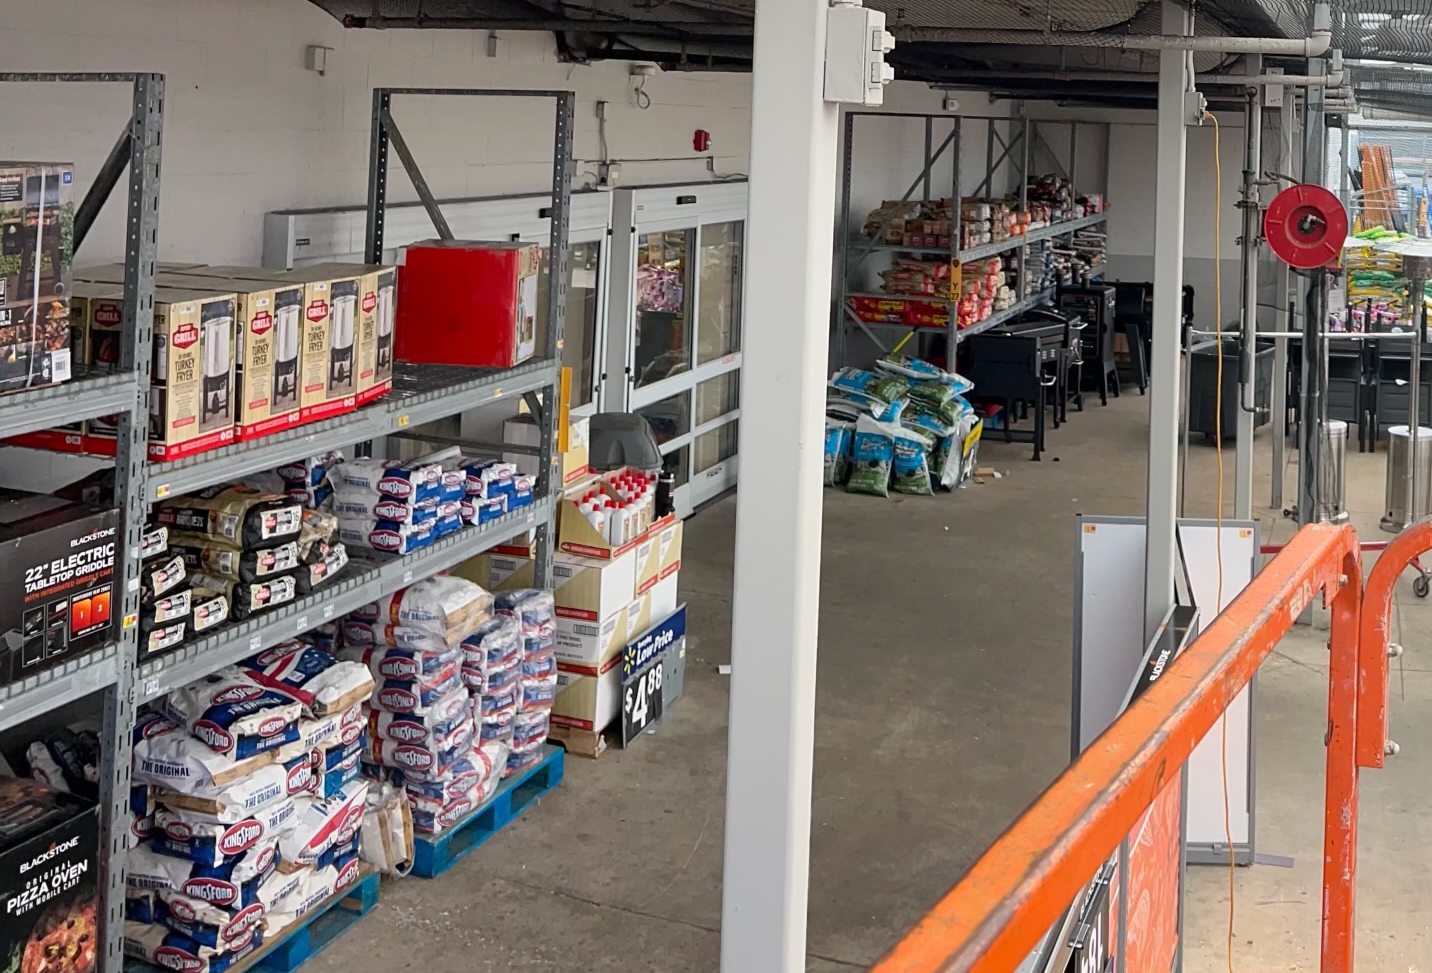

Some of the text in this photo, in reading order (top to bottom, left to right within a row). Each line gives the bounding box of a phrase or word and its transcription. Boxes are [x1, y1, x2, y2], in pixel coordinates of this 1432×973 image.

[952, 282, 959, 291] Y
[173, 331, 197, 345] GRILL
[174, 357, 196, 372] TURKEY
[176, 369, 194, 383] FRYER
[378, 482, 411, 495] KINGSFORD
[374, 505, 407, 517] KINGSFORD
[70, 526, 116, 548] BLACKSTONE
[370, 534, 402, 546] KINGSFORD
[24, 542, 115, 584] 22" ELECTRIC
[24, 556, 115, 594] TABLETOP GRIDDLE
[24, 567, 115, 603] WITH INTEGRATED GRIDDLE CART
[636, 629, 674, 666] Low Price
[214, 687, 264, 704] KINGSFORD
[194, 725, 229, 747] KINGSFORD
[259, 719, 286, 735] KINGSFORD
[389, 723, 427, 741] KINGSFORD
[393, 747, 431, 766] KINGSFORD
[141, 760, 191, 778] THE ORIGINAL
[244, 787, 282, 809] THE ORIGINAL
[222, 823, 261, 850] KINGSFORD
[20, 835, 81, 875] BLACKSTONE
[25, 859, 72, 890] ORIGINAL
[6, 858, 89, 914] PIZZA OVEN
[15, 875, 81, 917] WITH MOBILE CART
[186, 883, 234, 901] KINGSFORD
[226, 907, 263, 937] KINGSFORD
